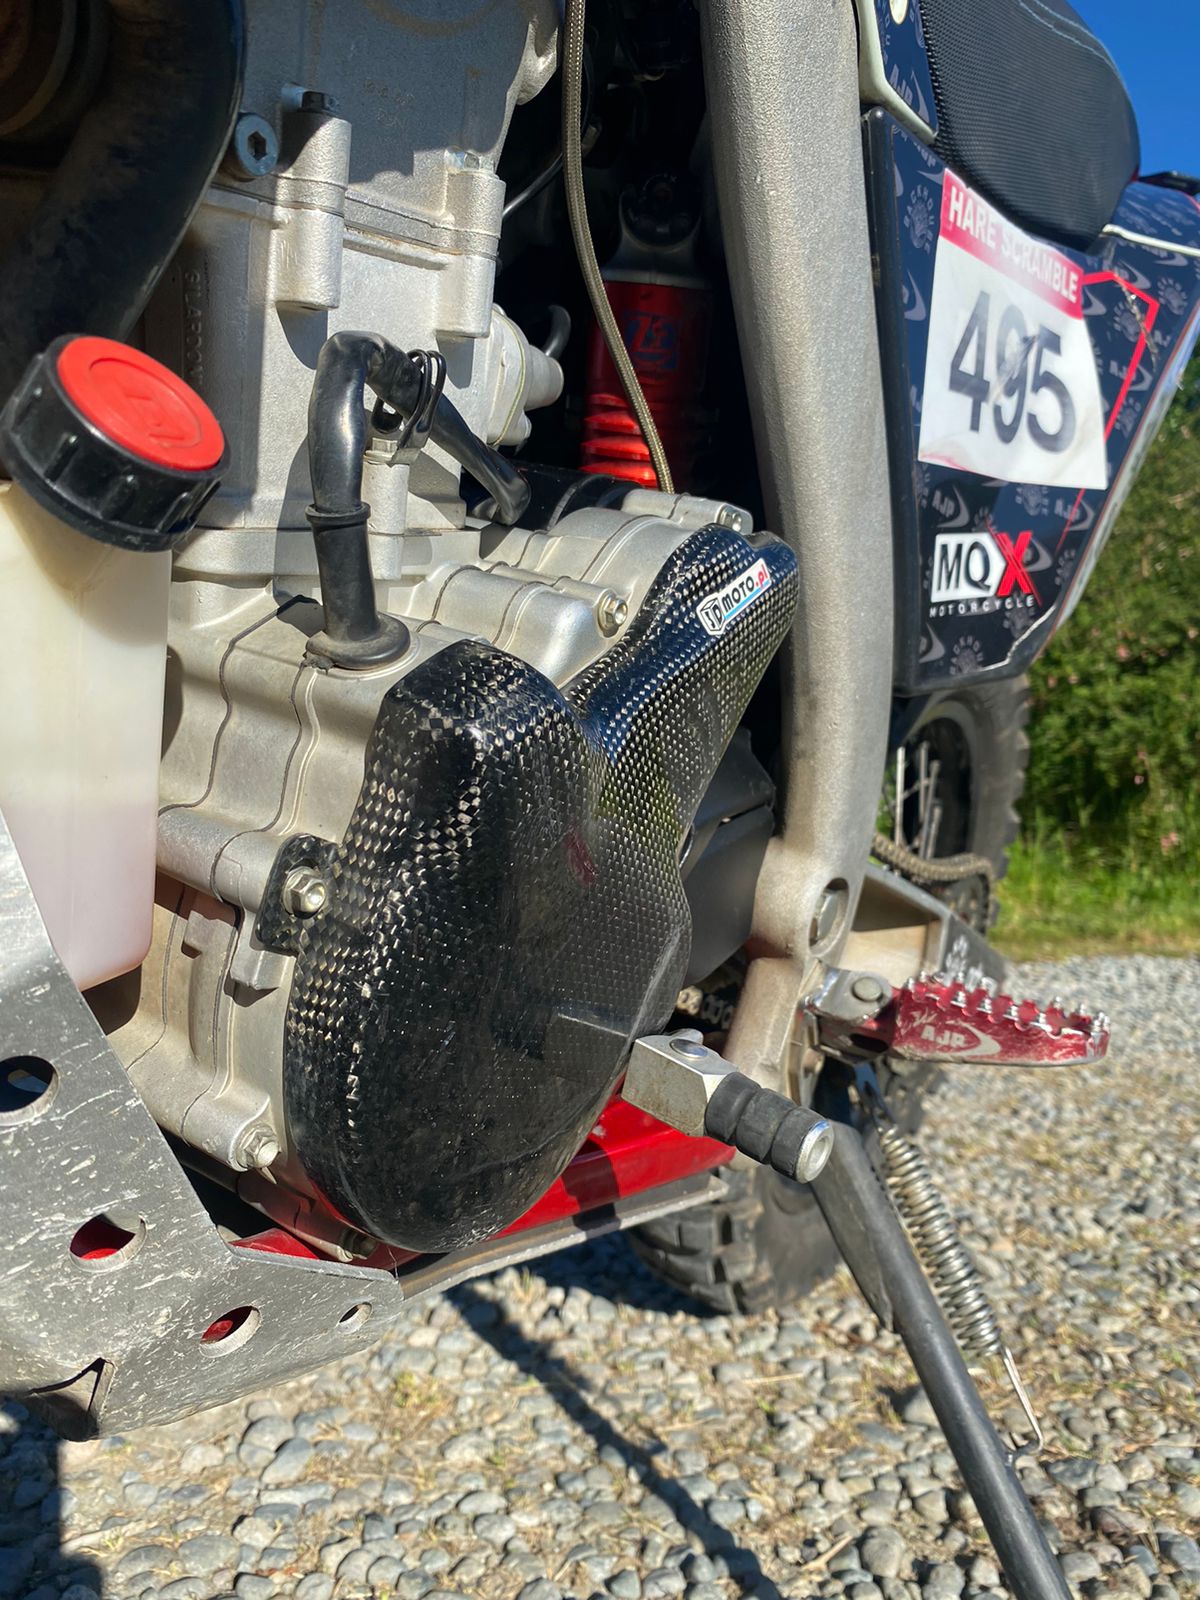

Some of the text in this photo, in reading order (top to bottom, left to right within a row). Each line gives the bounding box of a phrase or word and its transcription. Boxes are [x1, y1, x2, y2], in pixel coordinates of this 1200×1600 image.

[948, 186, 998, 247] HARE
[1000, 227, 1081, 304] SCRAMBLE
[948, 290, 1076, 454] 495
[929, 596, 1035, 618] MOTORCYCLE
[936, 529, 1036, 598] MQX
